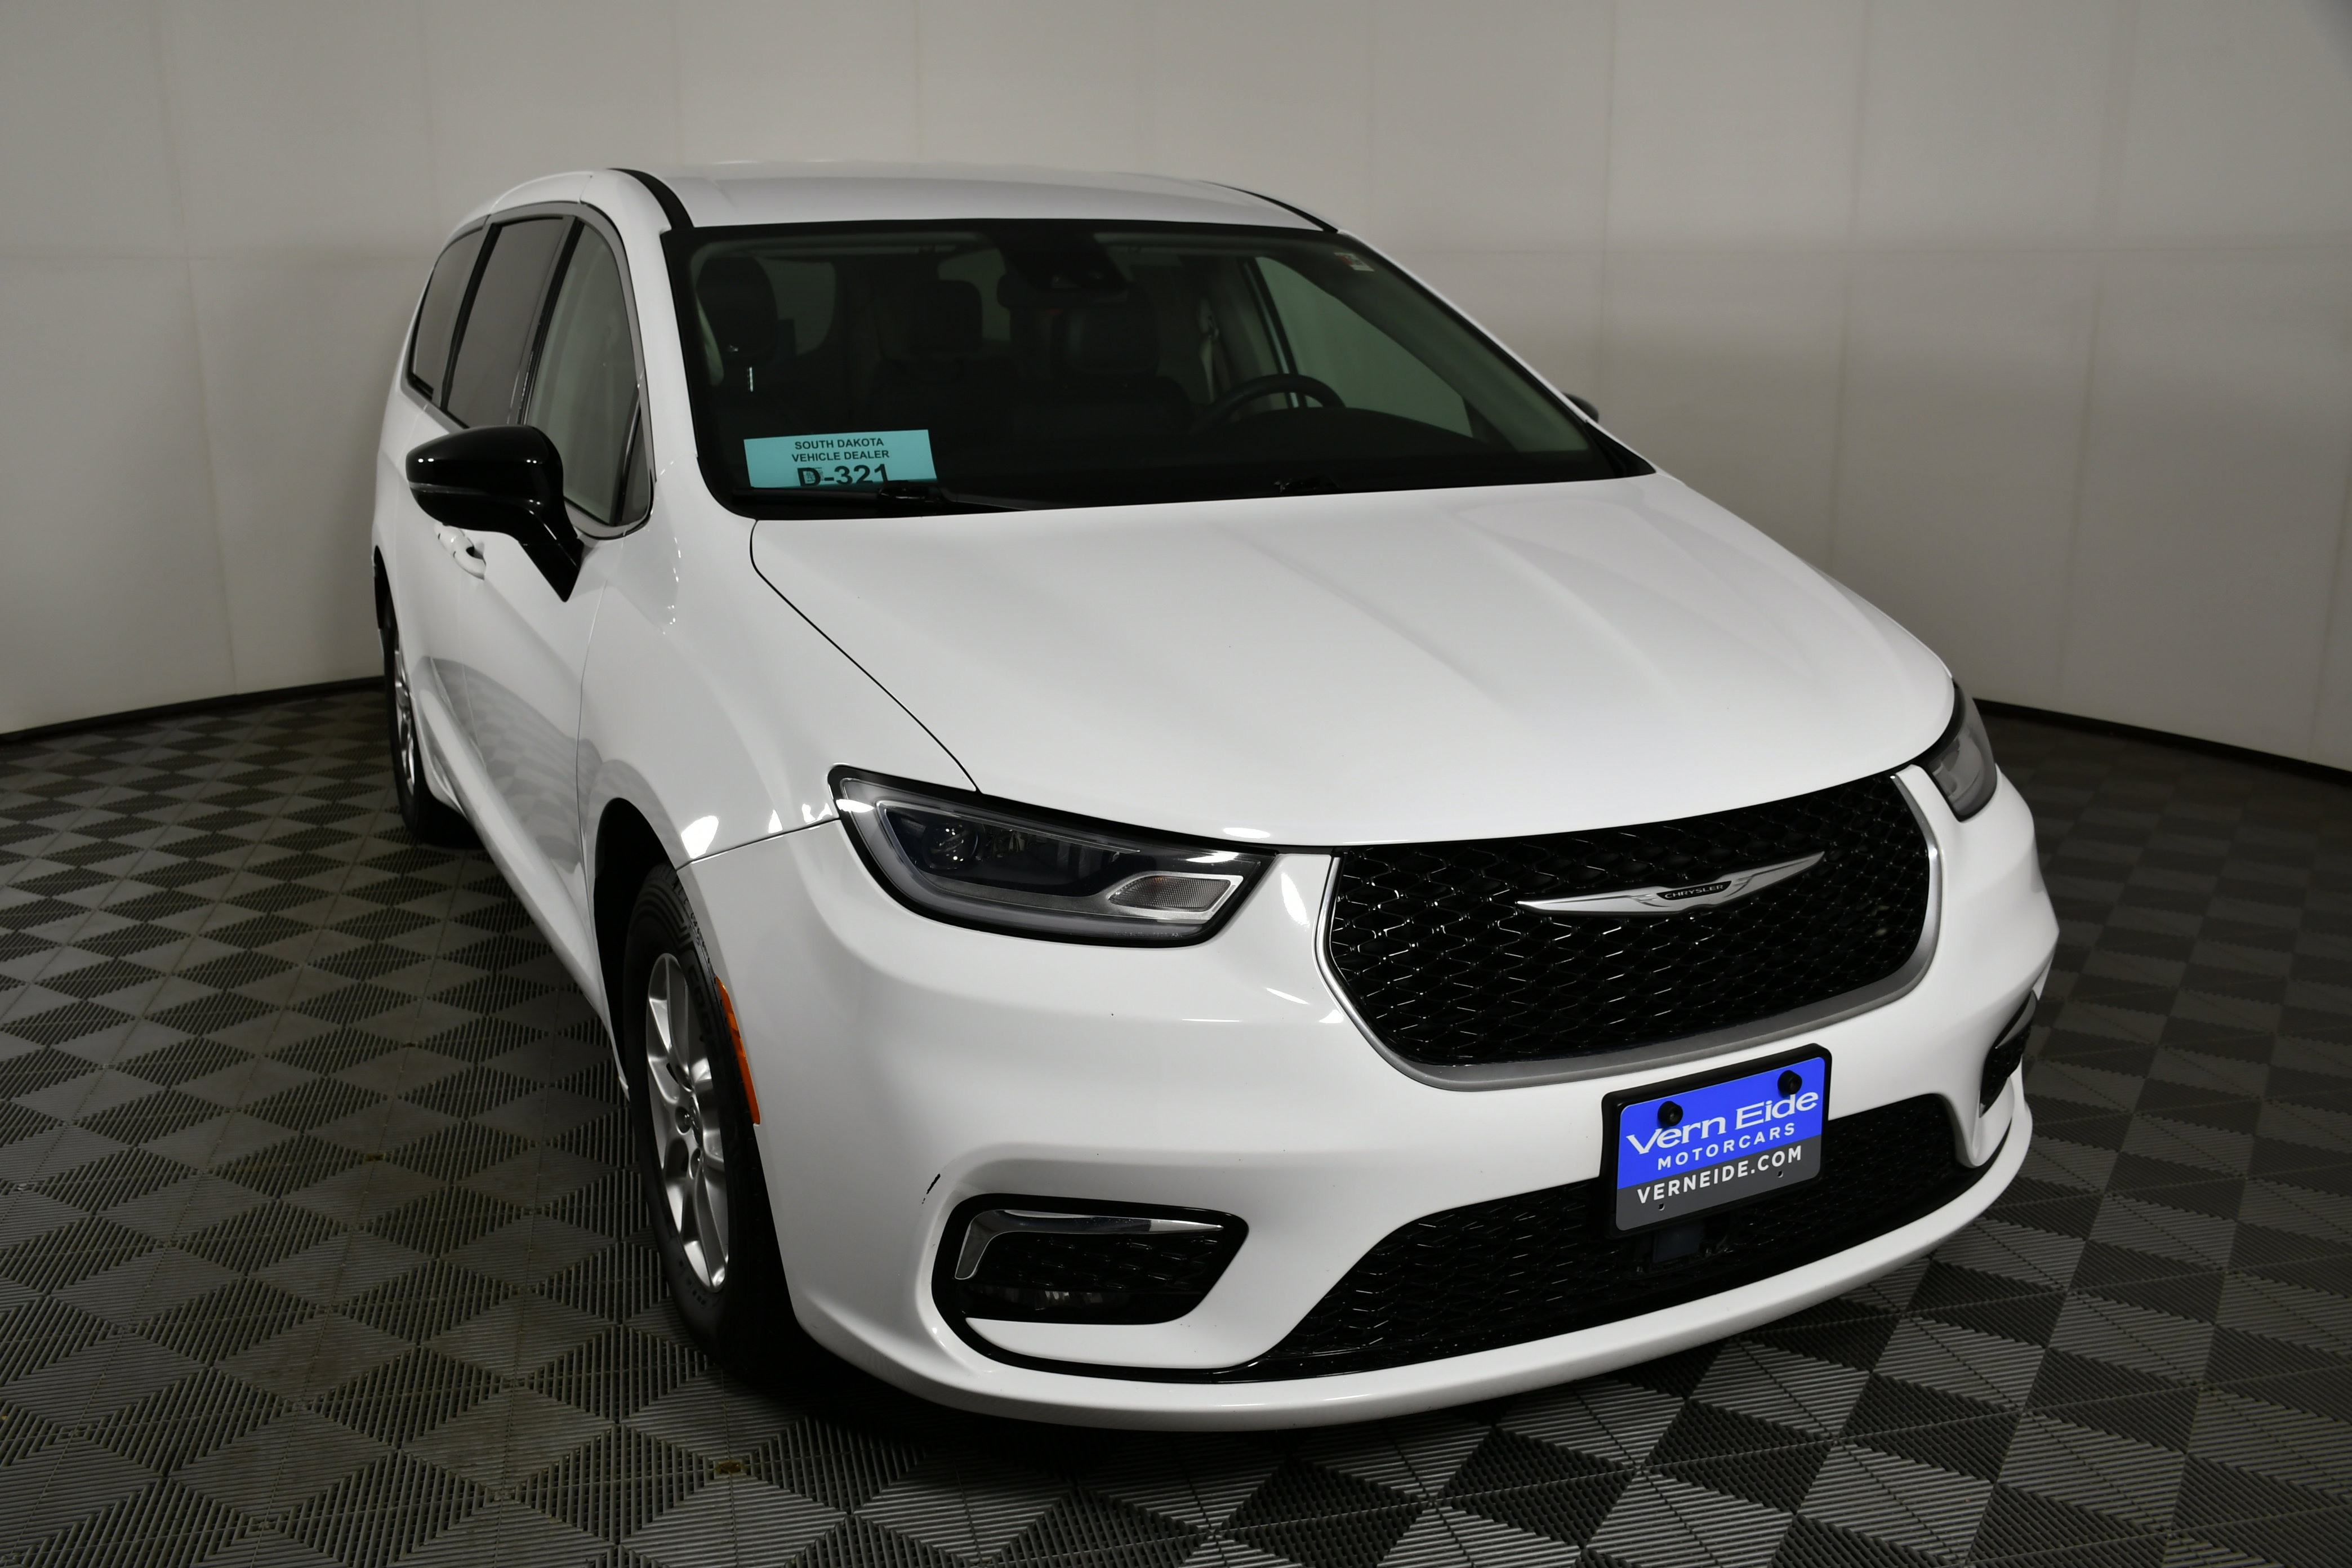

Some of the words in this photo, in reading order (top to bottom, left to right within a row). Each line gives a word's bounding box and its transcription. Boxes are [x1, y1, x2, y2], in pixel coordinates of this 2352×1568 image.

[795, 440, 834, 449] SOUTH
[837, 438, 884, 448] DAKOTA
[792, 452, 841, 462] VEHICLE
[844, 450, 889, 460] DEALER
[798, 464, 889, 486] D-321
[1664, 885, 1723, 898] CHRYSLER
[1626, 1115, 1726, 1155] Vern
[1735, 1092, 1819, 1130] Eide
[1658, 1122, 1795, 1170] MOTORCARS
[1637, 1146, 1802, 1204] VERNEIDE.COM
